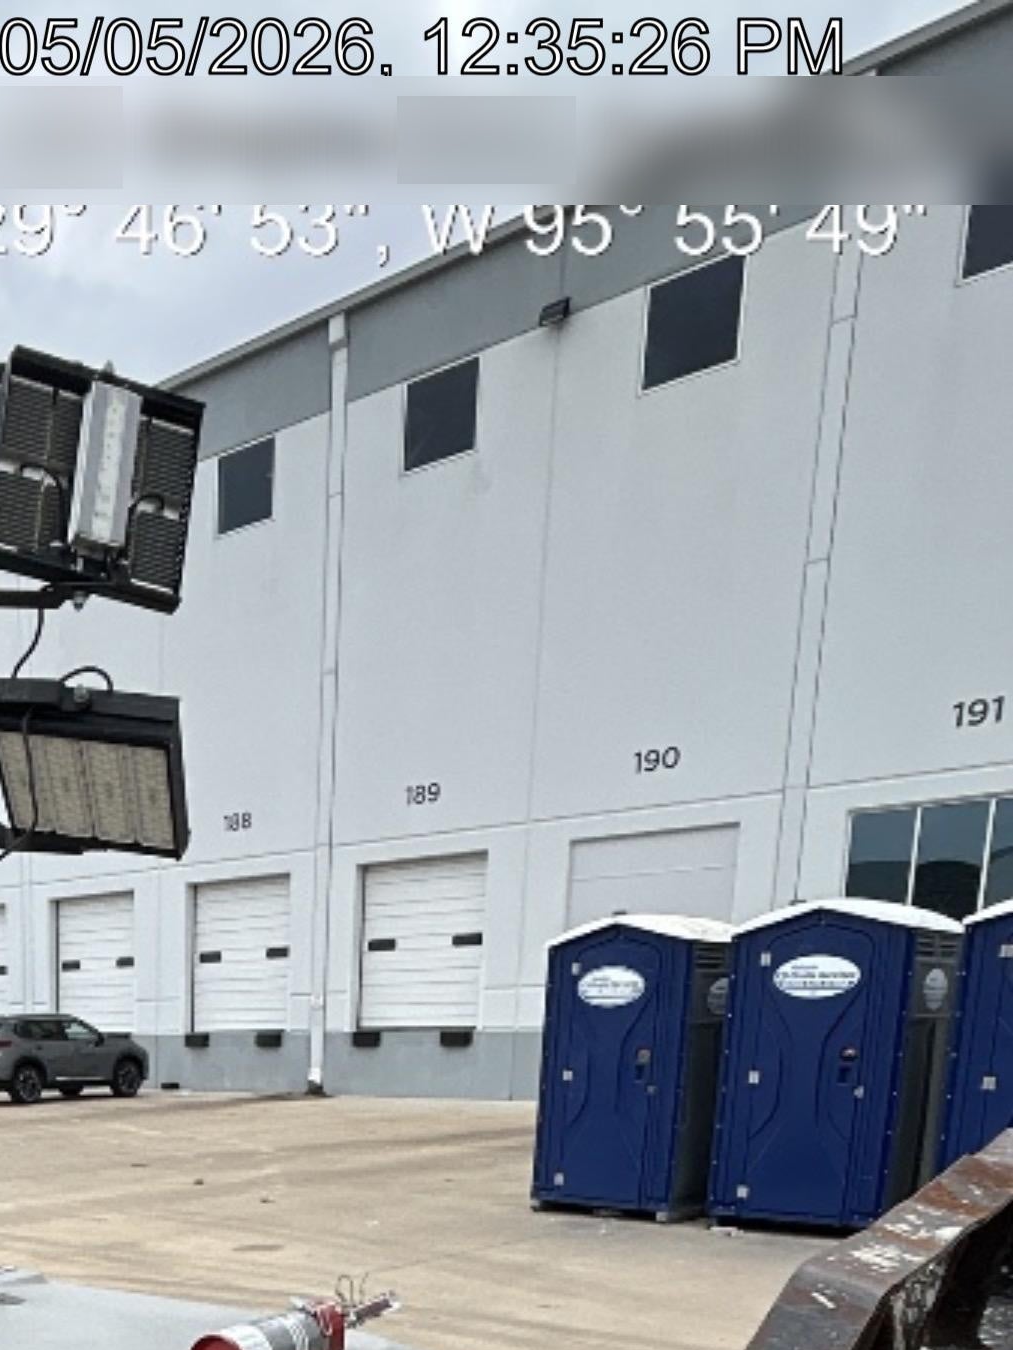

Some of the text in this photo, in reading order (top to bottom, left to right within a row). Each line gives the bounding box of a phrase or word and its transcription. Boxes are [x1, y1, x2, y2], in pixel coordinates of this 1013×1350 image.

[953, 695, 1005, 728] 191
[633, 746, 681, 774] 190
[405, 781, 442, 806] 189
